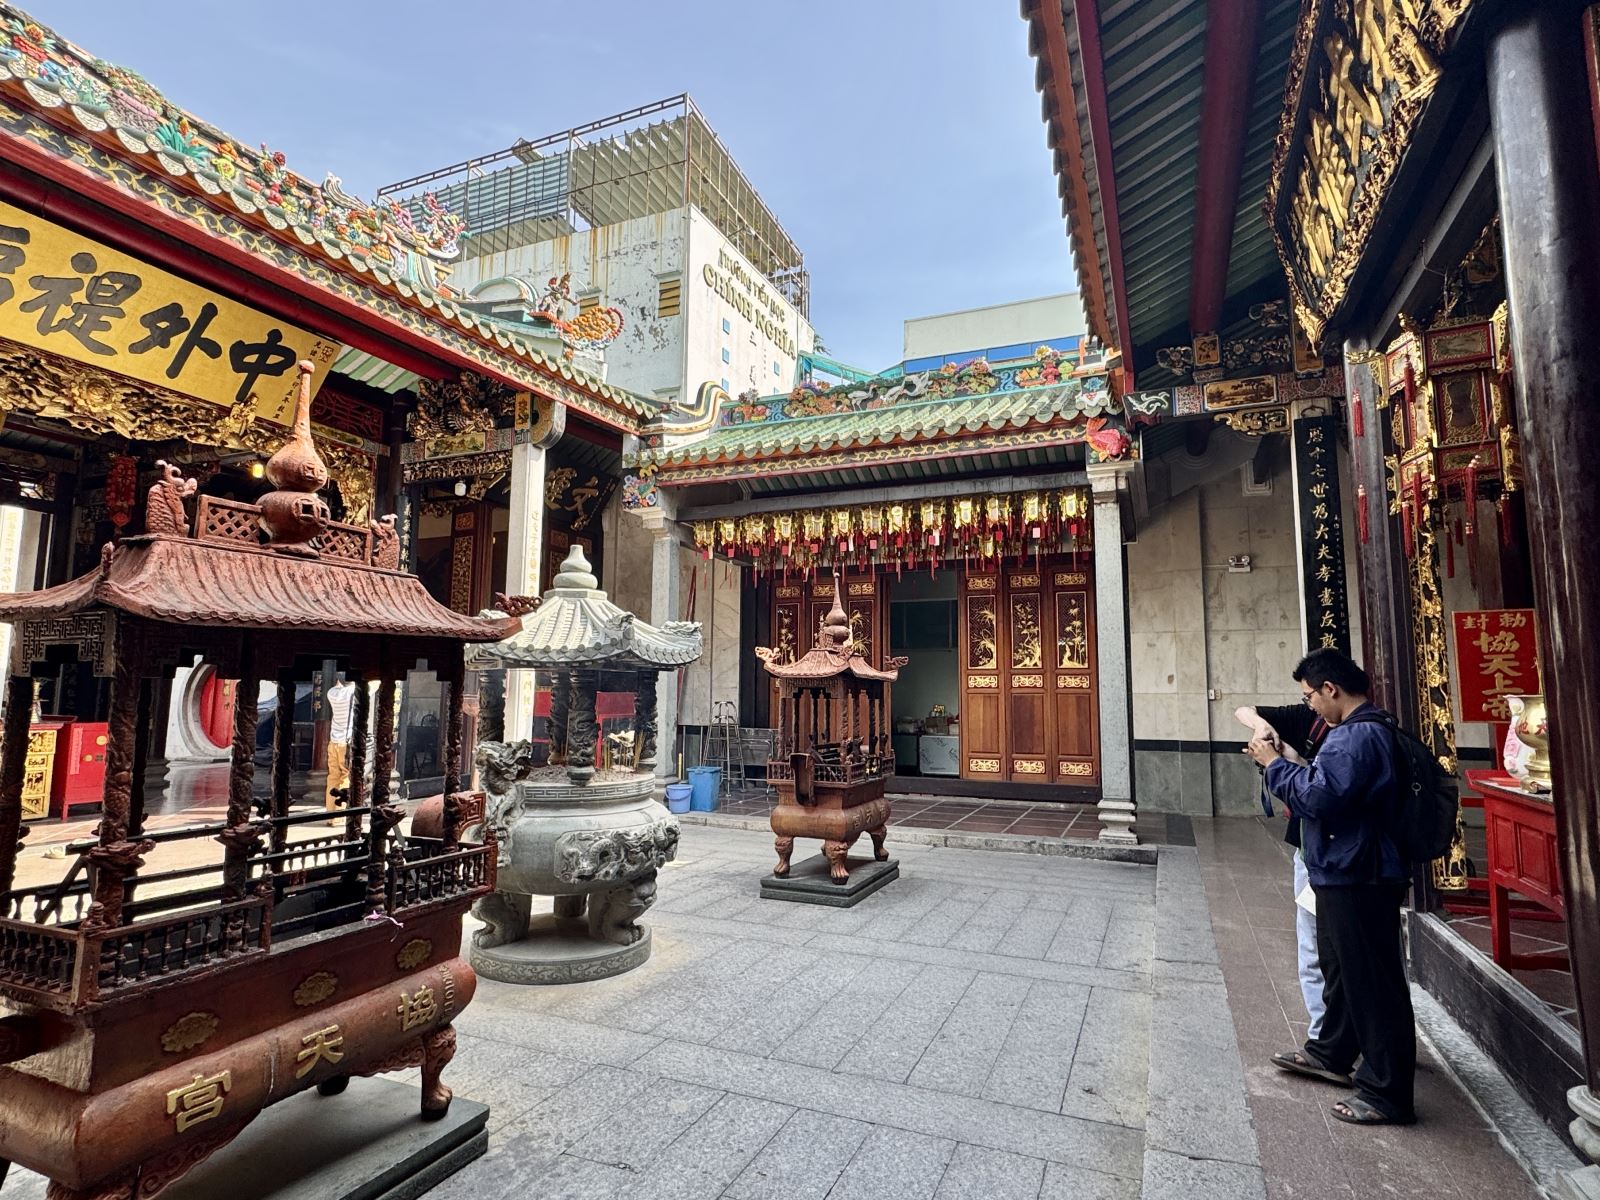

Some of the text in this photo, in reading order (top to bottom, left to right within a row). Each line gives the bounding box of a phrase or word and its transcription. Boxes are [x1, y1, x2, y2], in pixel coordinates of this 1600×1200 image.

[0, 225, 297, 402] 中外禔
[703, 263, 797, 360] CHÍNH NGHĨA
[753, 281, 769, 308] TIỂU
[770, 298, 785, 323] HỌC
